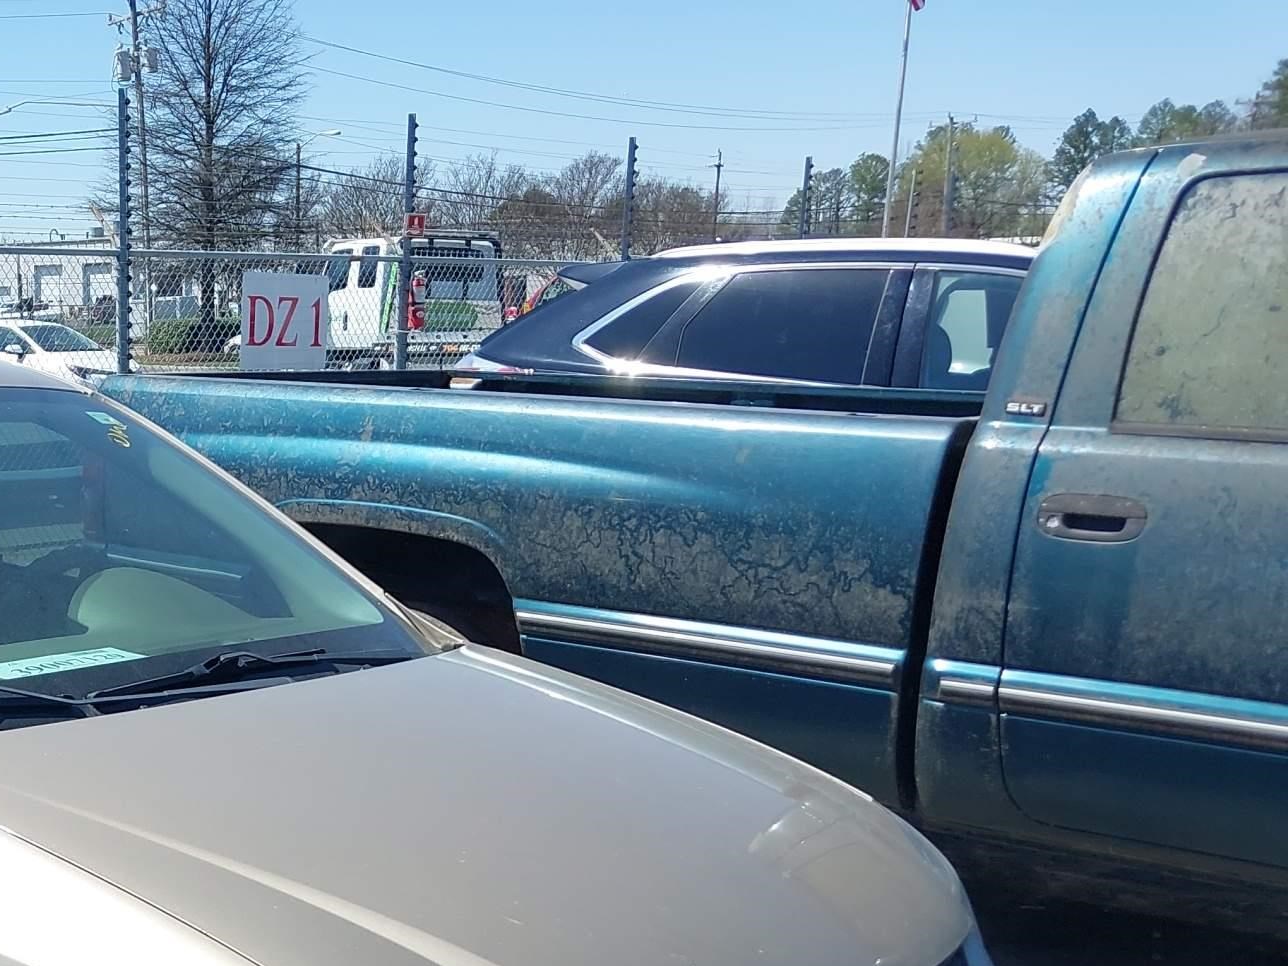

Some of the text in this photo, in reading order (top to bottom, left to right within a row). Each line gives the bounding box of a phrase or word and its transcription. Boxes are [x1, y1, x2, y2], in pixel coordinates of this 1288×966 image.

[245, 295, 323, 347] DZ 1
[1005, 402, 1044, 414] SLT
